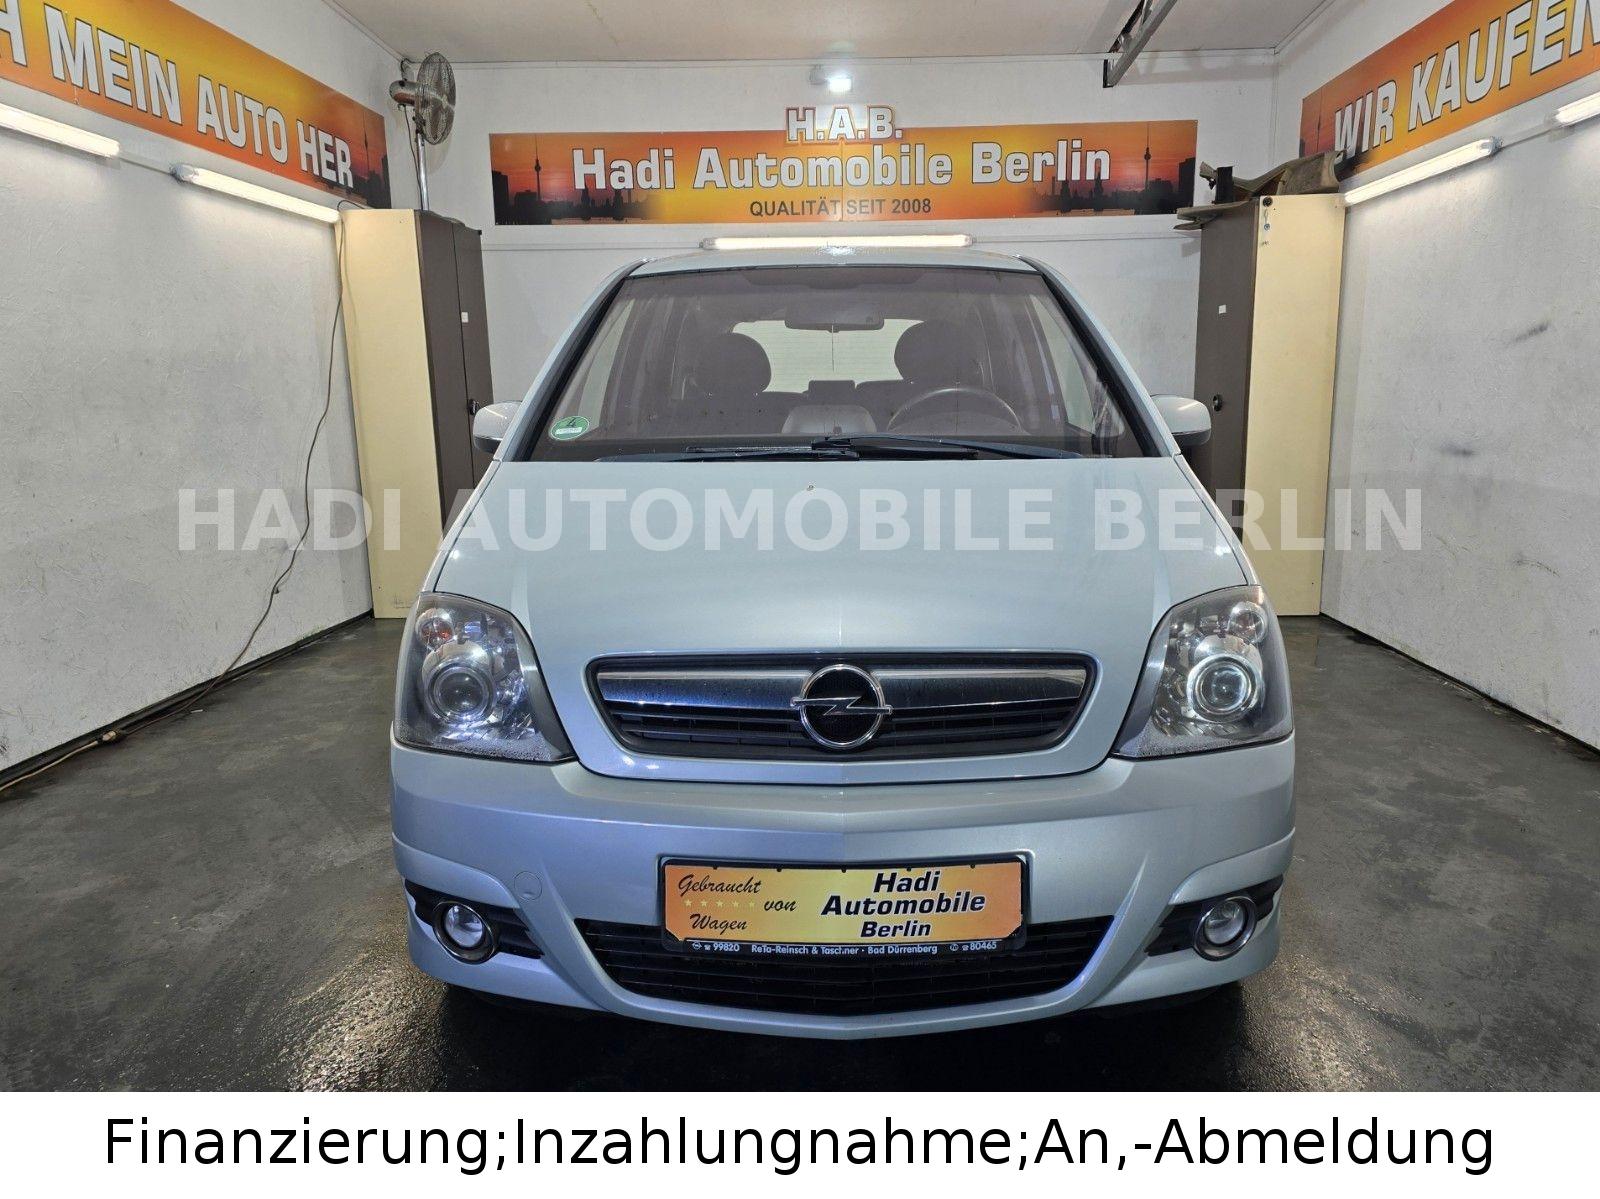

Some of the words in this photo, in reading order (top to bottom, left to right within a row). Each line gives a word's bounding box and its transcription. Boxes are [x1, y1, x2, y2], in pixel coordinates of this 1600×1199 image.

[43, 2, 182, 126] MEIN
[197, 74, 288, 164] AUTO
[296, 118, 354, 188] HER
[786, 105, 903, 142] H.A.B.
[1334, 79, 1397, 160] WIR
[572, 147, 675, 189] Hadi
[692, 142, 953, 189] Automobile
[971, 139, 1110, 184] Berlin
[750, 196, 840, 216] QUALITÄT
[846, 199, 886, 214] SEIT
[891, 198, 931, 214] 2008
[678, 874, 761, 896] Gebraucht
[873, 871, 941, 893] Hadi
[764, 900, 796, 912] von
[821, 892, 986, 916] Automobile
[690, 913, 747, 935] Wagen
[860, 920, 932, 938] Berlin
[713, 943, 740, 952] 99820
[867, 946, 885, 954] Bad
[970, 941, 997, 951] 80465
